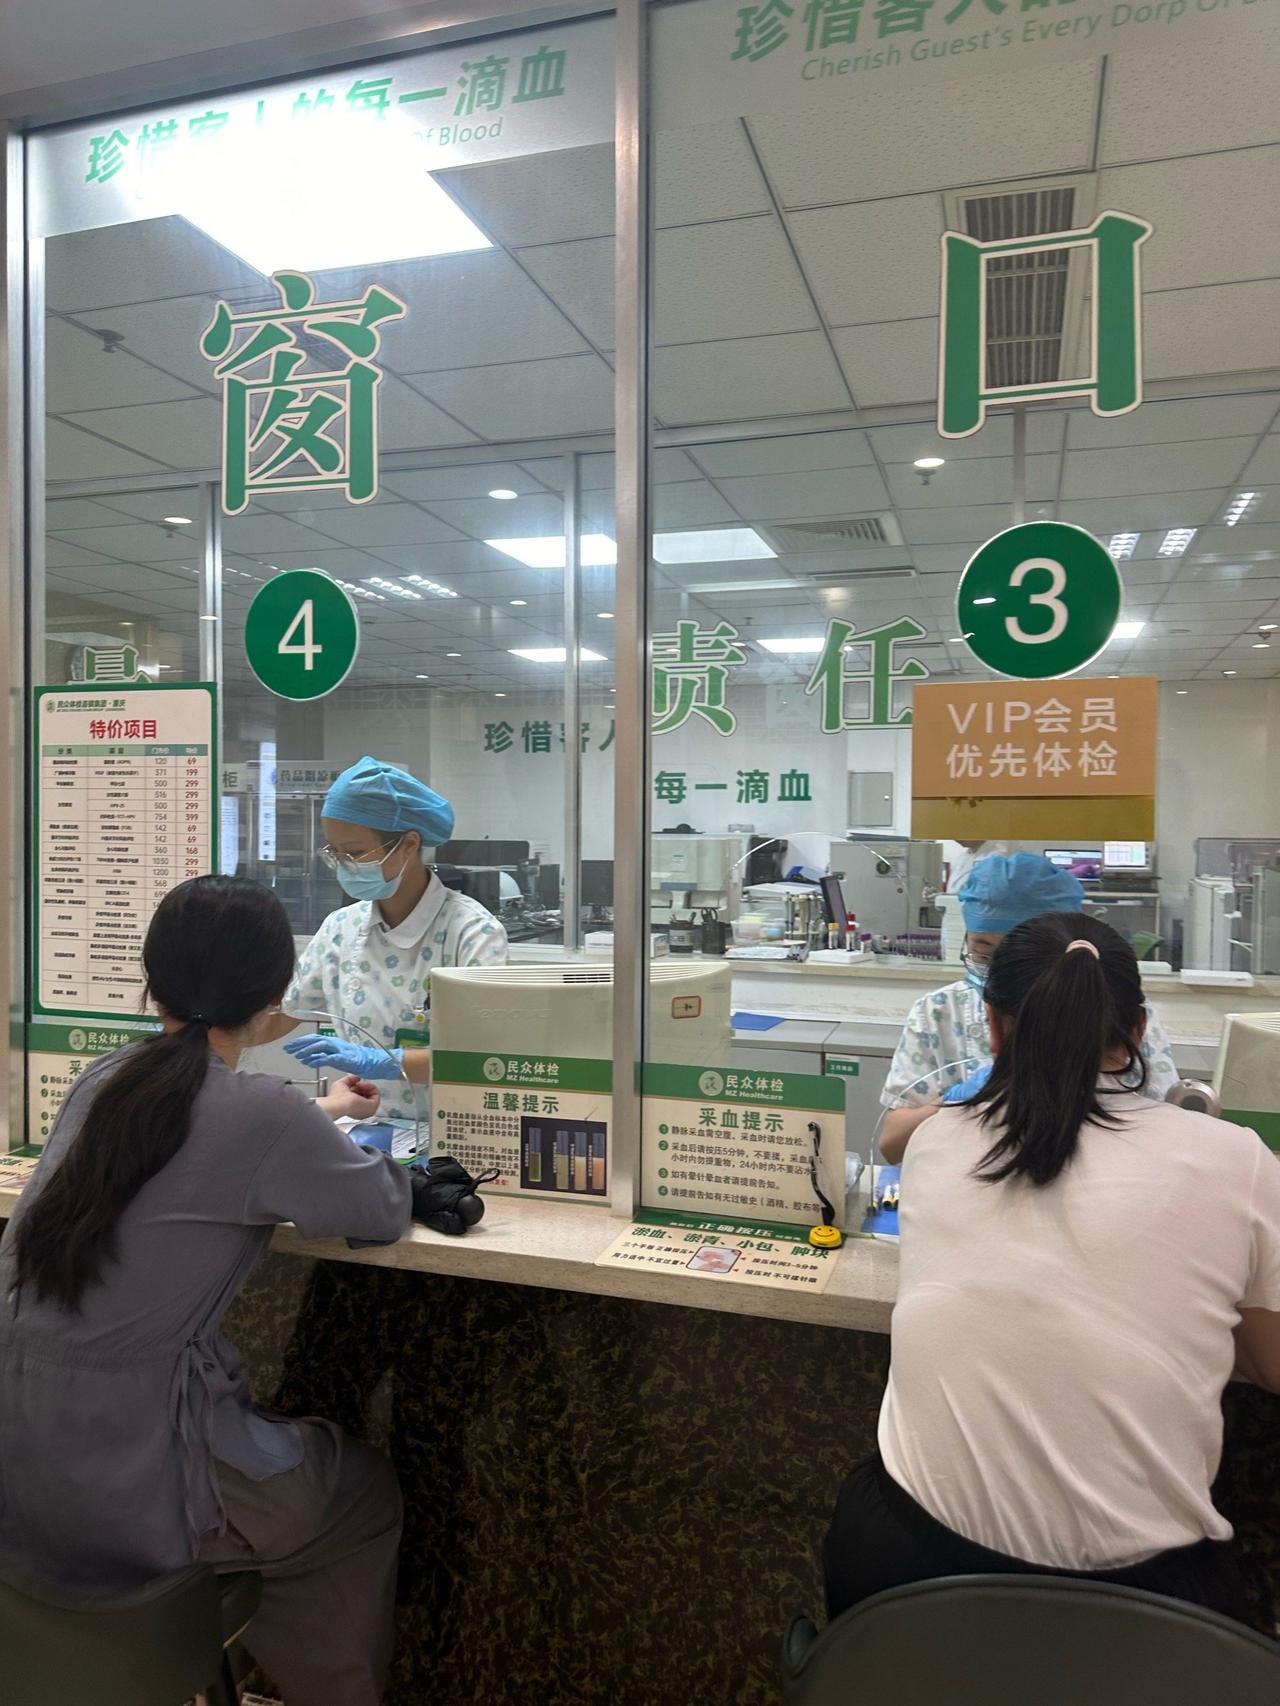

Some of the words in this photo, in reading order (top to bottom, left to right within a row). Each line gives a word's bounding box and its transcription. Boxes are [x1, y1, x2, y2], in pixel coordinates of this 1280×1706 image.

[800, 47, 900, 81] Cherish
[910, 29, 1013, 62] Guest's
[1021, 14, 1103, 39] Every
[1111, 3, 1186, 28] Dorp
[439, 117, 503, 146] Blood
[937, 209, 1155, 440] 口
[200, 270, 407, 516] 窗
[1004, 557, 1069, 645] 3
[277, 599, 322, 670] 4
[947, 697, 1119, 735] VIP会员
[90, 719, 158, 740] 特价项目
[154, 757, 168, 766] 120
[187, 757, 198, 766] 69
[945, 740, 1119, 779] 优先体检
[185, 768, 199, 777] 199
[154, 779, 168, 788] 500
[185, 779, 200, 788] 299
[654, 768, 813, 804] 每一滴血
[185, 790, 200, 799] 299
[154, 801, 169, 810] 500
[185, 802, 200, 810] 299
[185, 813, 200, 822] 399
[154, 823, 168, 832] 142
[187, 824, 198, 833] 69
[187, 835, 198, 844] 69
[185, 847, 199, 855] 168
[185, 857, 200, 866] 299
[152, 868, 170, 877] 1200
[185, 868, 200, 877] 299
[507, 1060, 560, 1075] 民众体检
[726, 1075, 784, 1092] 民众体检
[483, 1091, 560, 1114] 温馨提示
[698, 1107, 785, 1133] 采血提示
[698, 1222, 775, 1238] 正确按压
